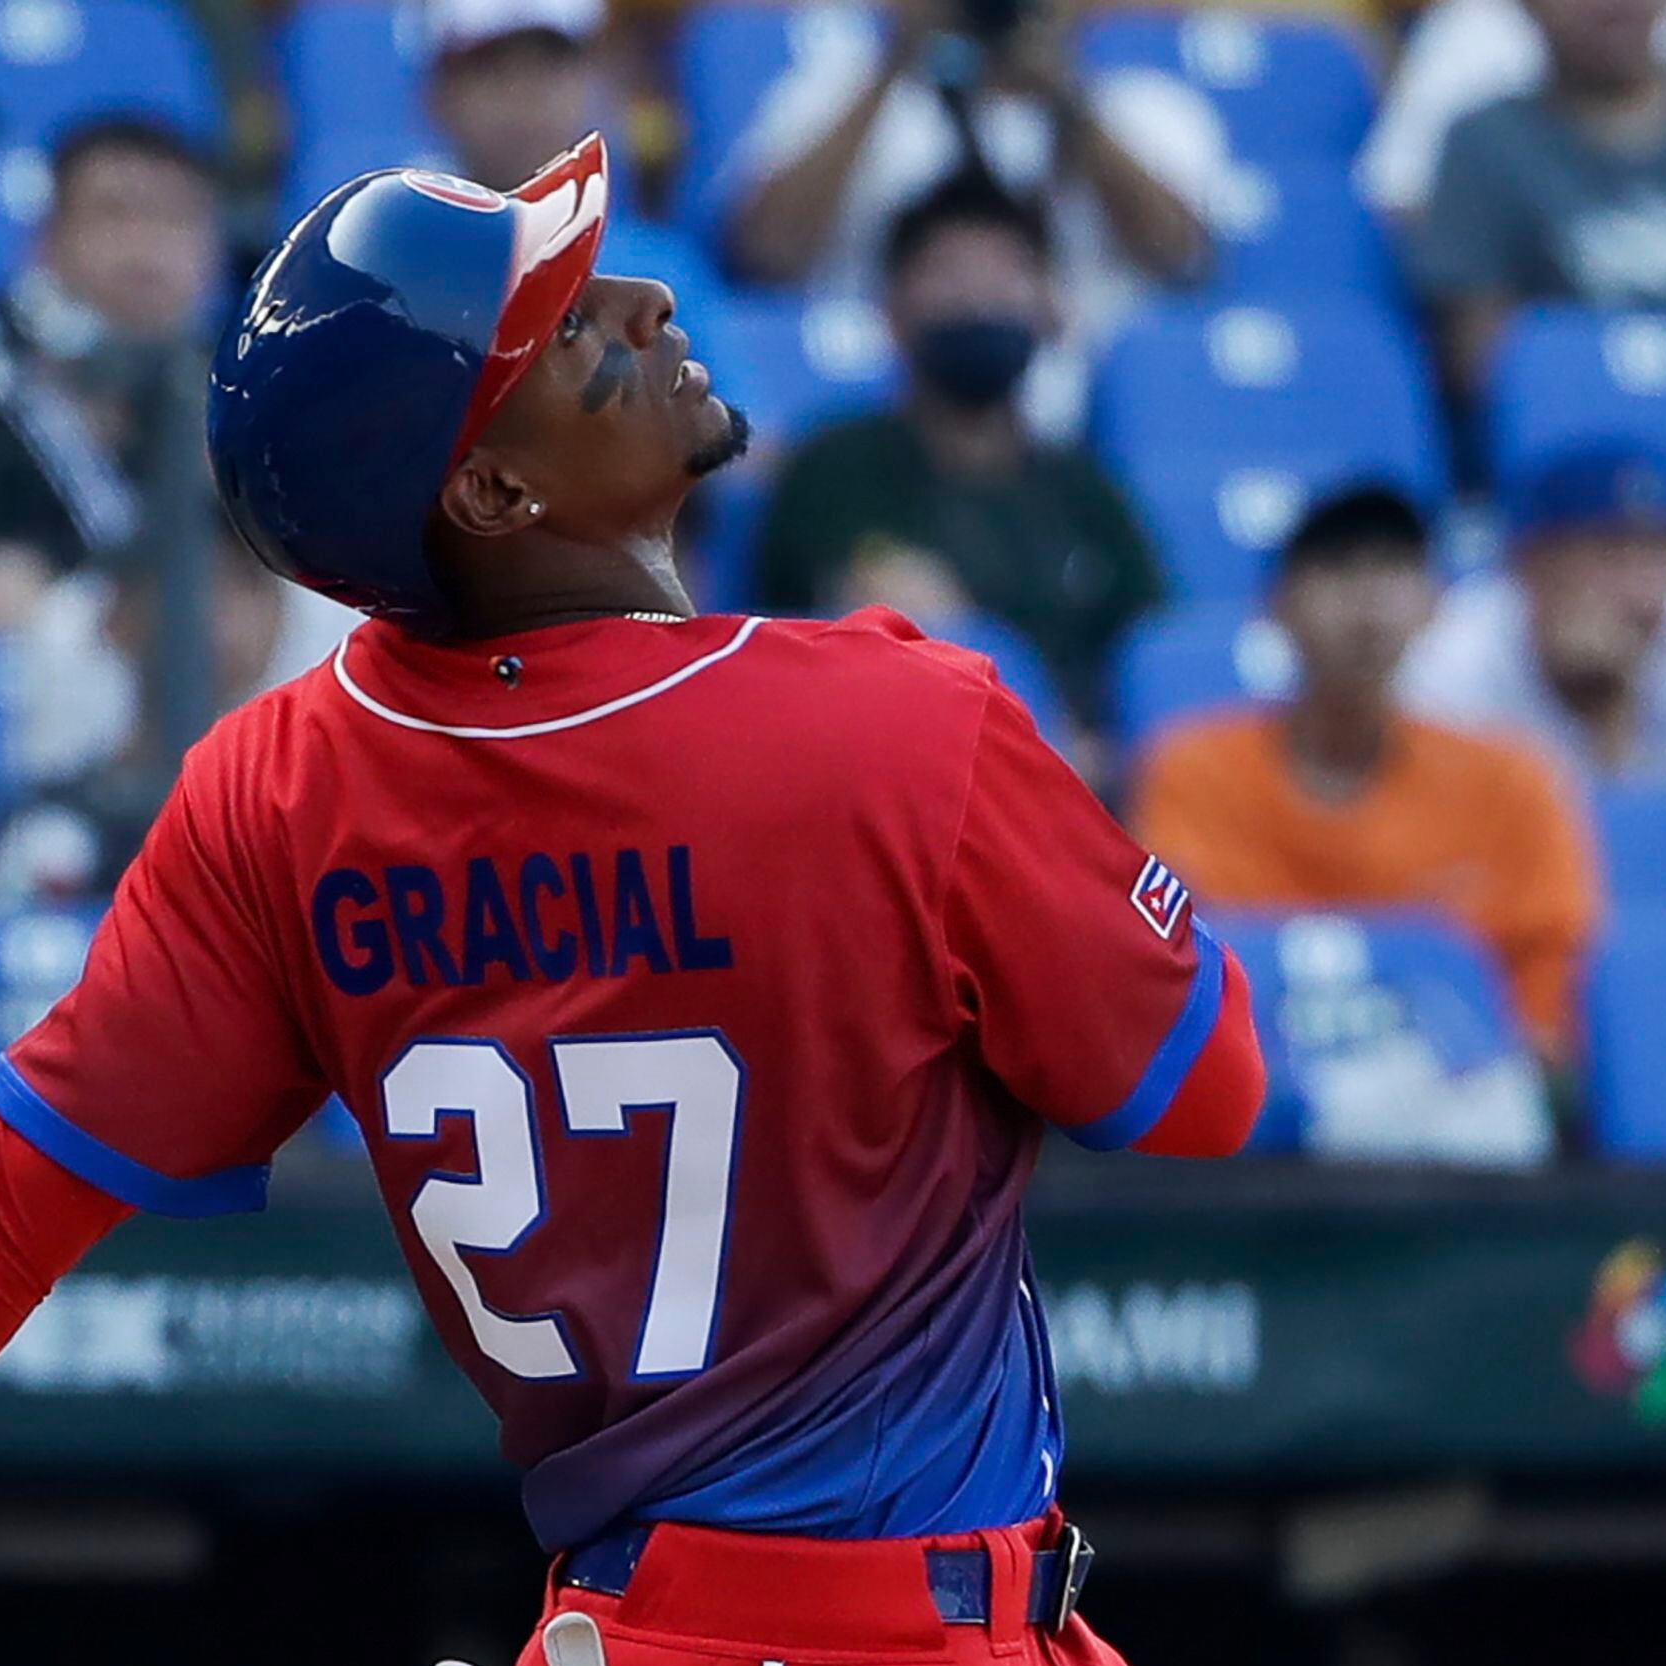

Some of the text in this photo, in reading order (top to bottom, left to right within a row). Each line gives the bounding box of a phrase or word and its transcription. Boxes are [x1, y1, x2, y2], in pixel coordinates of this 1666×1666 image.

[311, 844, 733, 997] GRACIAL
[379, 1026, 748, 1384] 27
[1051, 1285, 1260, 1386] AMI
